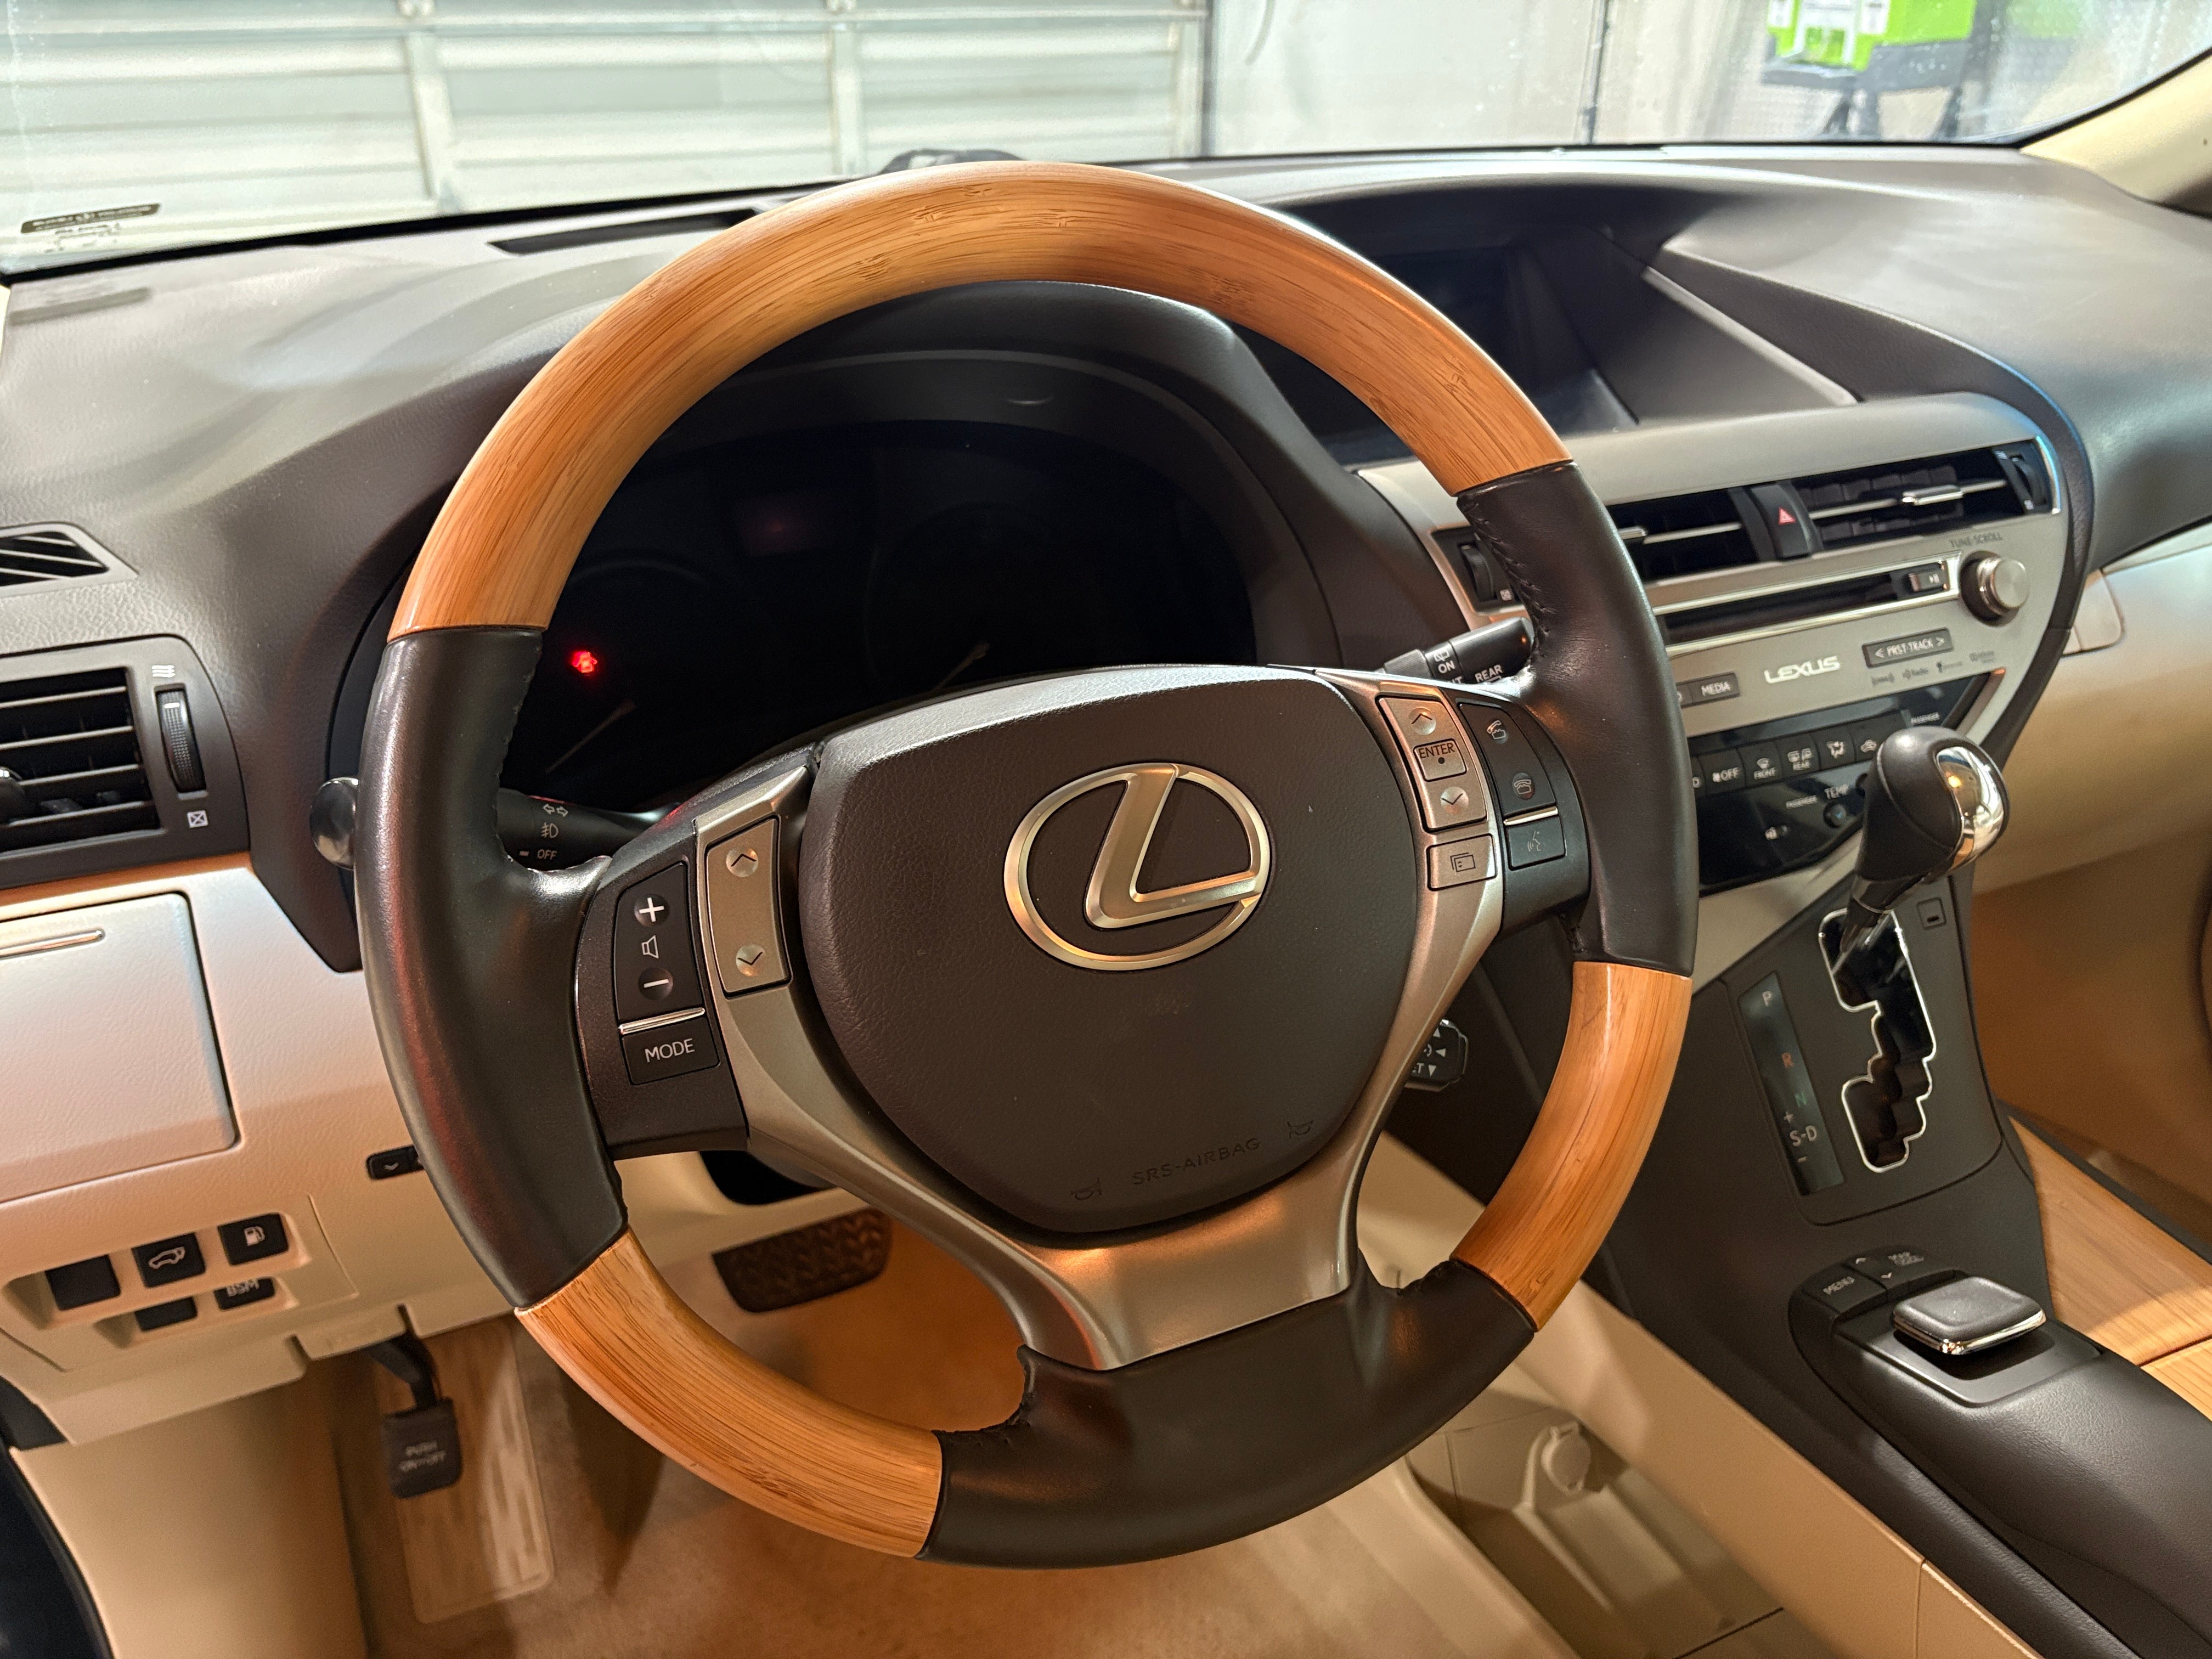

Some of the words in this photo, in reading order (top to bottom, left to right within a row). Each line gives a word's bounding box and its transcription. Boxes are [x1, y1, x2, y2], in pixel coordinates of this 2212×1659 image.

[1438, 660, 1455, 674] ON
[1475, 664, 1503, 683] REAR
[1764, 656, 1841, 684] LEXUS
[1701, 681, 1731, 696] MEDIA
[1418, 742, 1455, 759] ENTER
[1720, 767, 1740, 781] OFF
[538, 849, 557, 861] OFF
[1762, 991, 1774, 1007] P
[645, 1038, 695, 1063] MODE
[1782, 1052, 1795, 1068] R
[1132, 1138, 1260, 1185] SRS-AIRBAG
[1823, 1276, 1855, 1295] MENU
